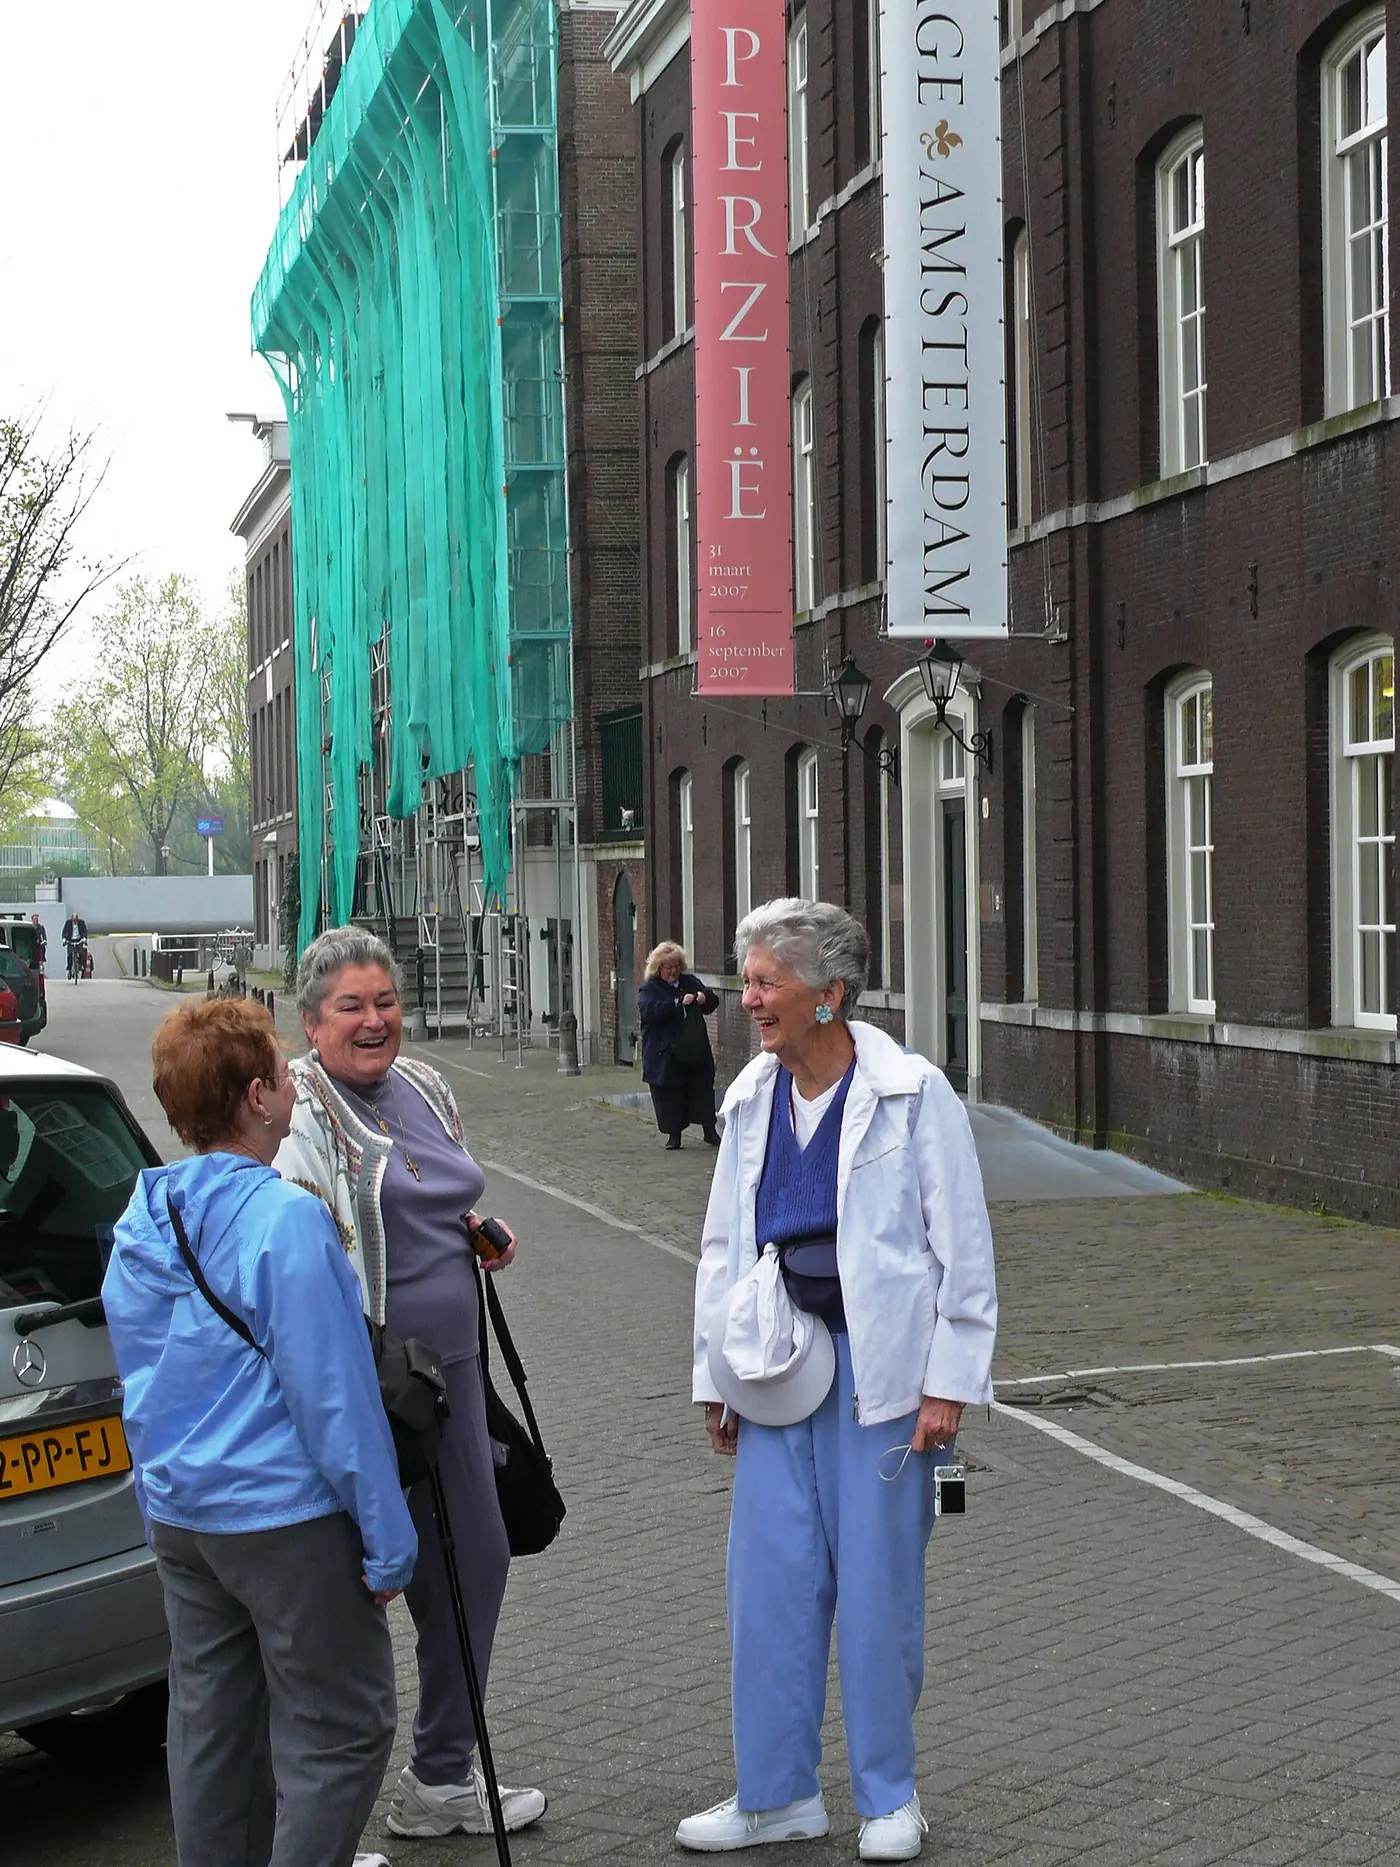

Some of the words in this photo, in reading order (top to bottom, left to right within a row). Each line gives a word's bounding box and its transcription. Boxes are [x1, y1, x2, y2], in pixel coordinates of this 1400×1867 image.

[915, 0, 965, 106] GE
[717, 27, 775, 521] PERZIË
[918, 165, 972, 622] AMSTERDAM
[709, 544, 722, 559] 31
[708, 564, 752, 577] maart
[709, 585, 749, 600] 2007
[709, 624, 726, 637] 16
[708, 641, 786, 662] september
[709, 667, 749, 681] 2007
